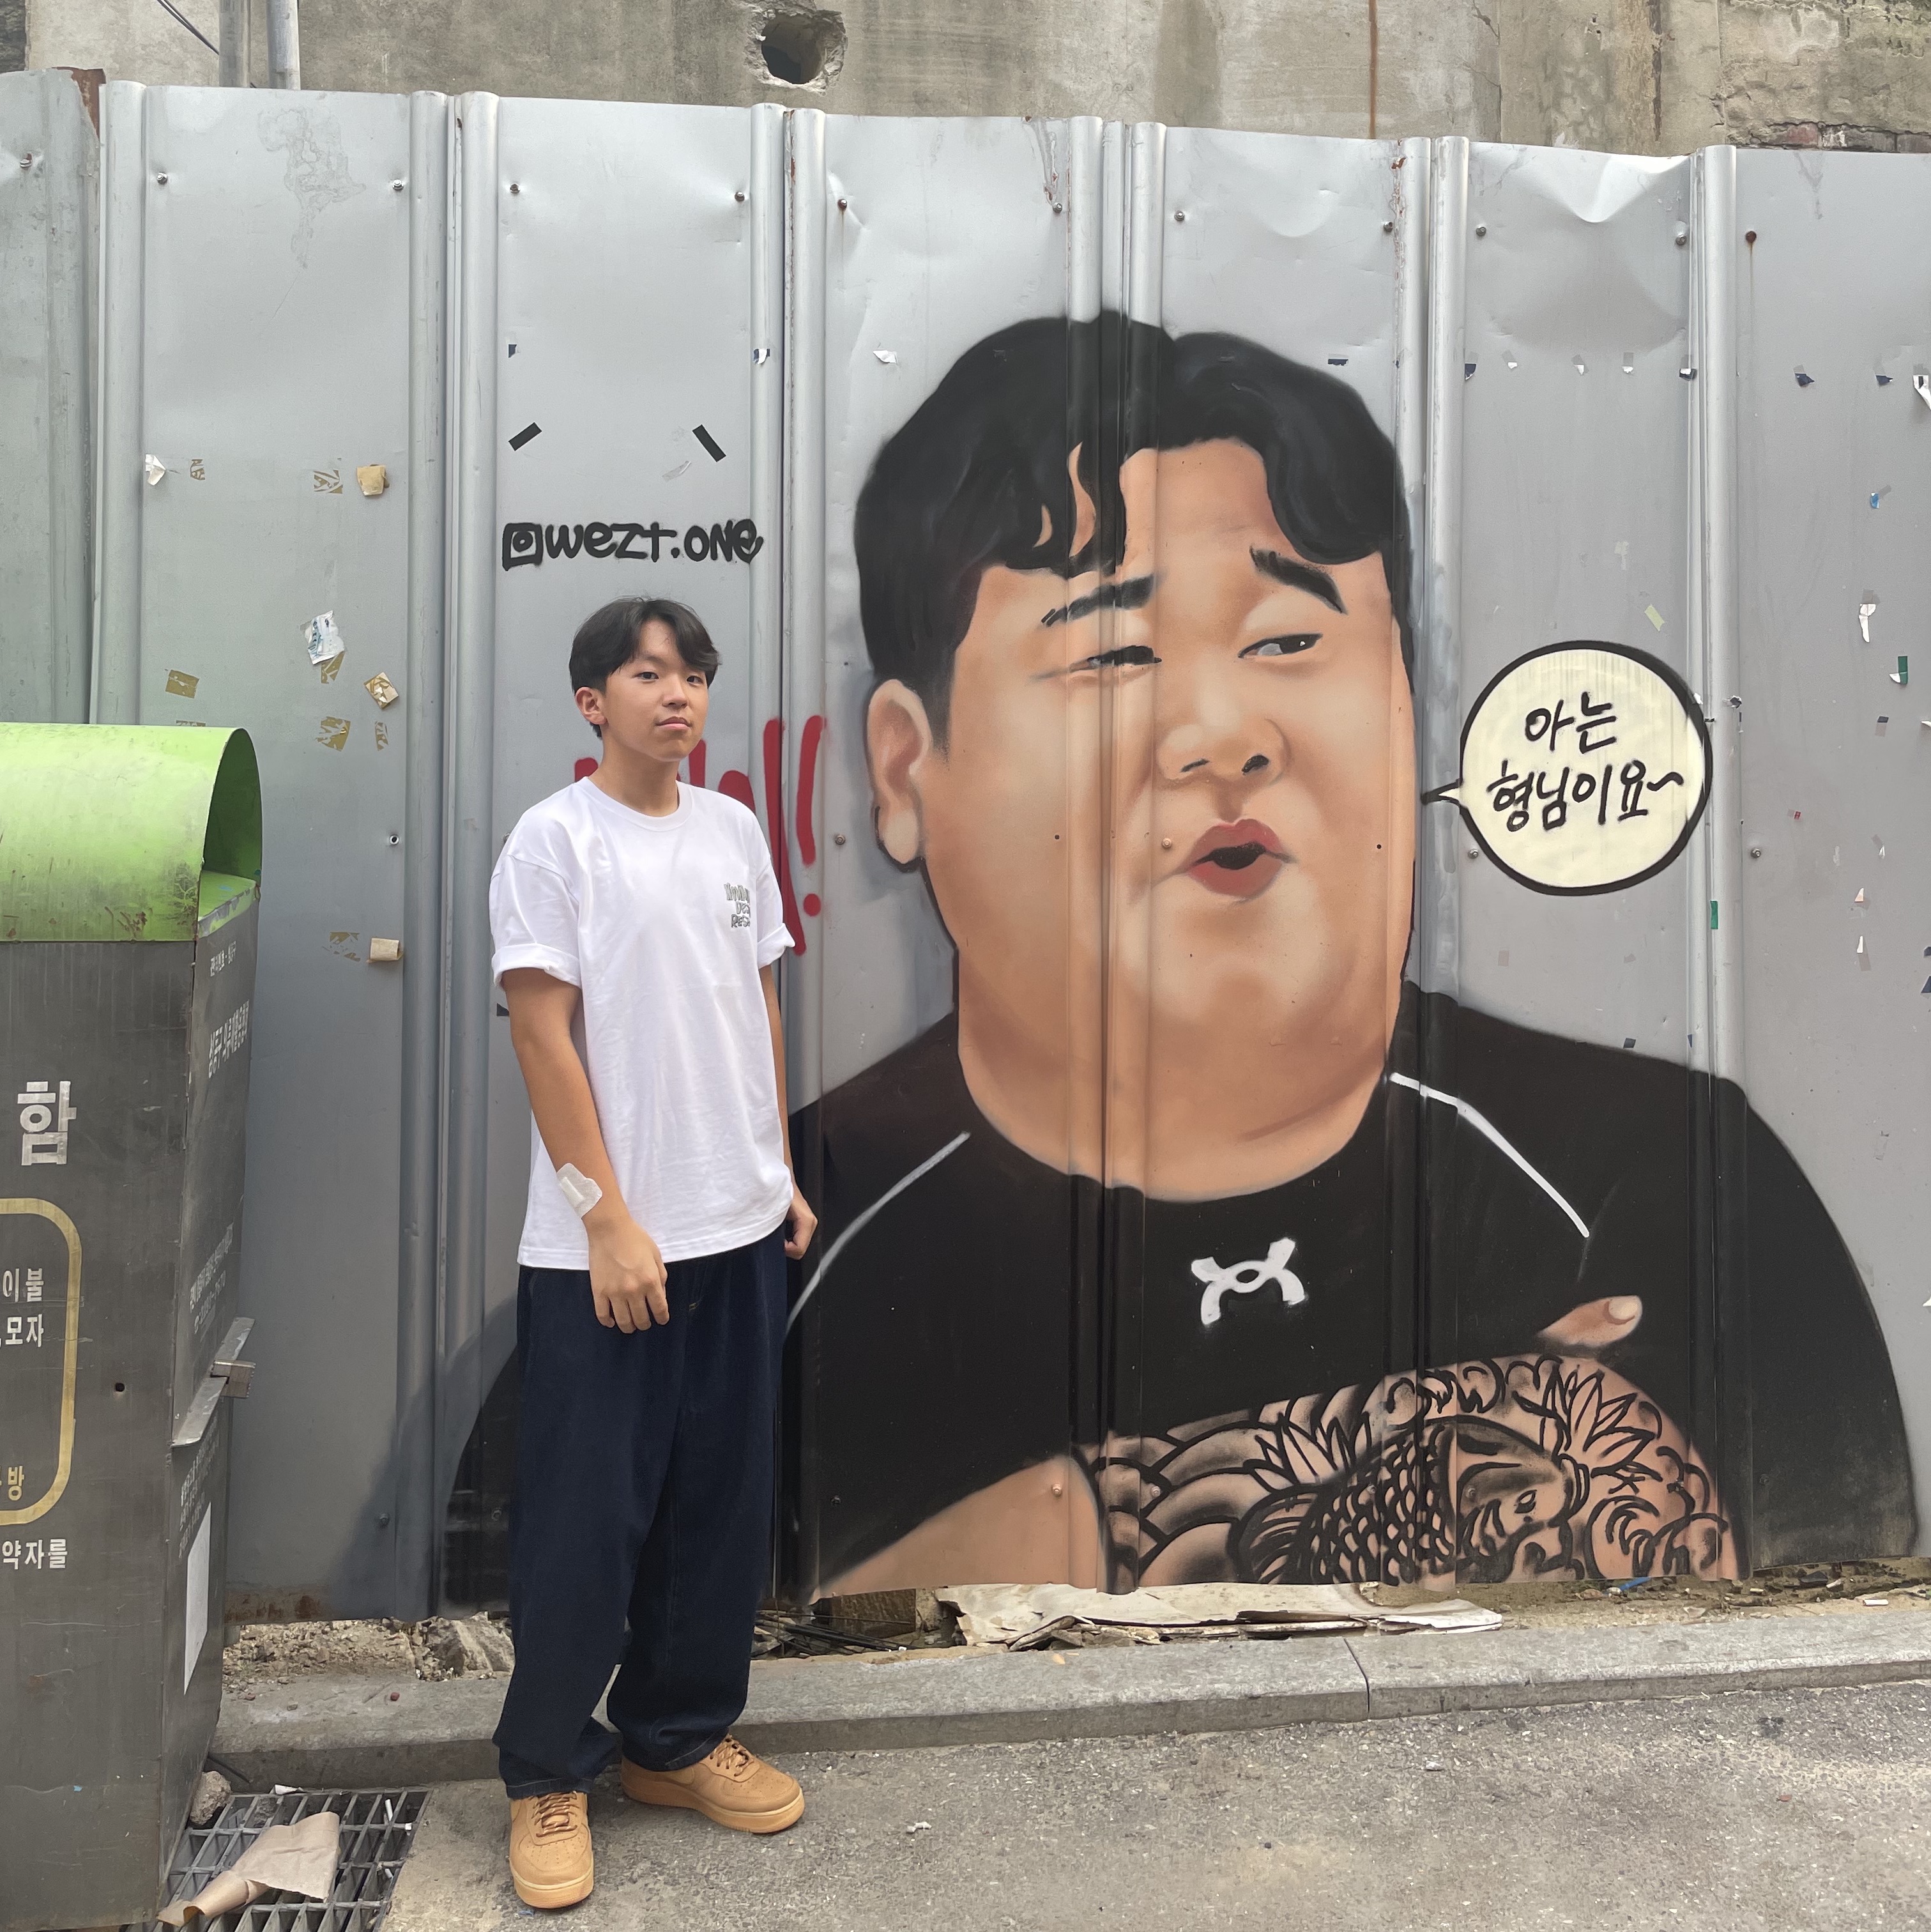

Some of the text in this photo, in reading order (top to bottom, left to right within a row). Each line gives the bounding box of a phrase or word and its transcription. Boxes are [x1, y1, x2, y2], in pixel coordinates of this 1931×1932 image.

[1525, 691, 1617, 754] 아는
[1486, 758, 1684, 832] 형님이요~
[18, 1081, 77, 1165] 함
[3, 1268, 44, 1303] 이불
[2, 1538, 68, 1570] 약자를
